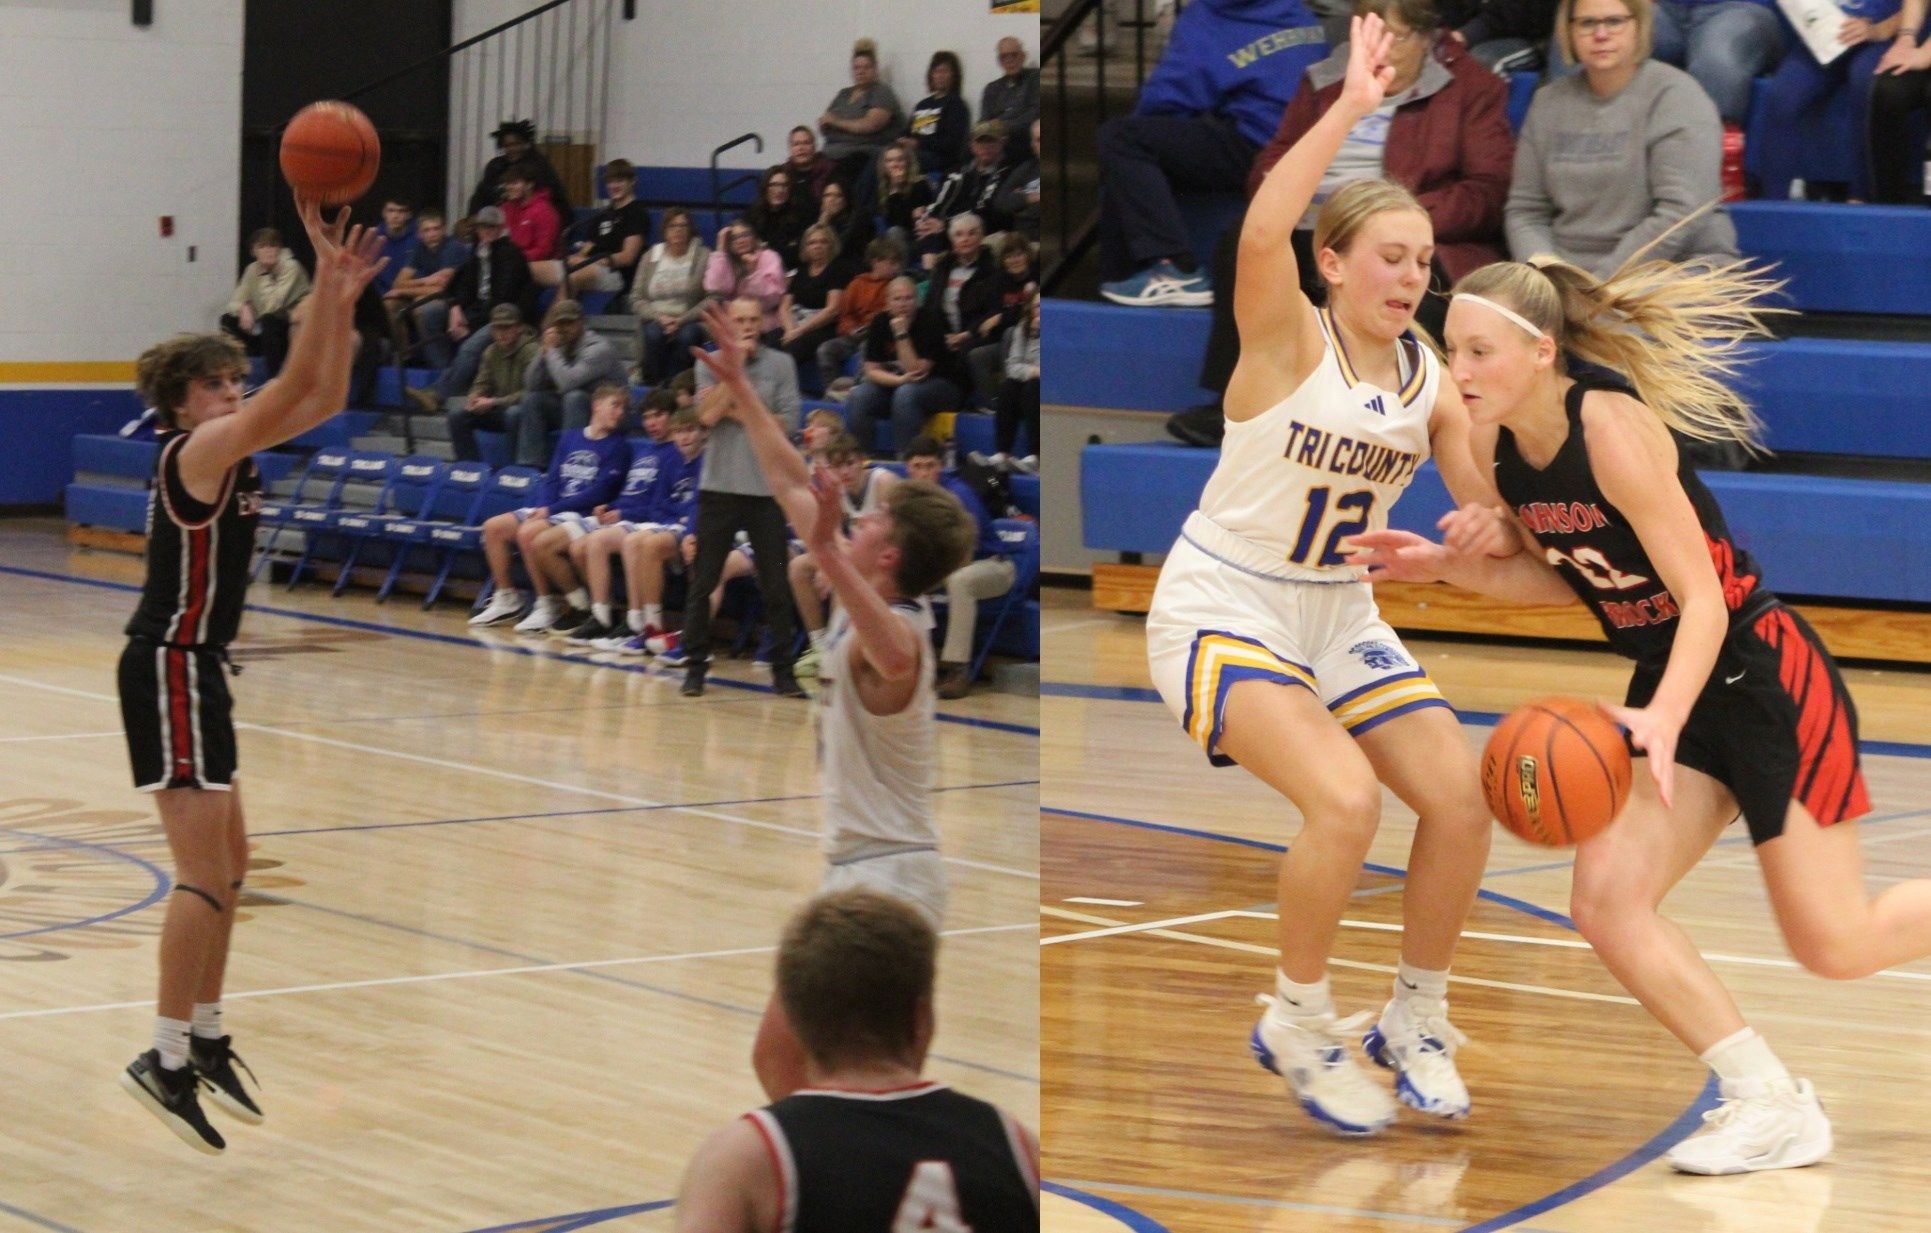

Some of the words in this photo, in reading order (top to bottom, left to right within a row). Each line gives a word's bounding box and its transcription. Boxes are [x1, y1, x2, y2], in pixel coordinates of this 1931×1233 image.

[1283, 420, 1331, 470] TRI
[1329, 436, 1421, 486] COUNTY
[1288, 484, 1377, 568] 12
[889, 1158, 974, 1233] 4
